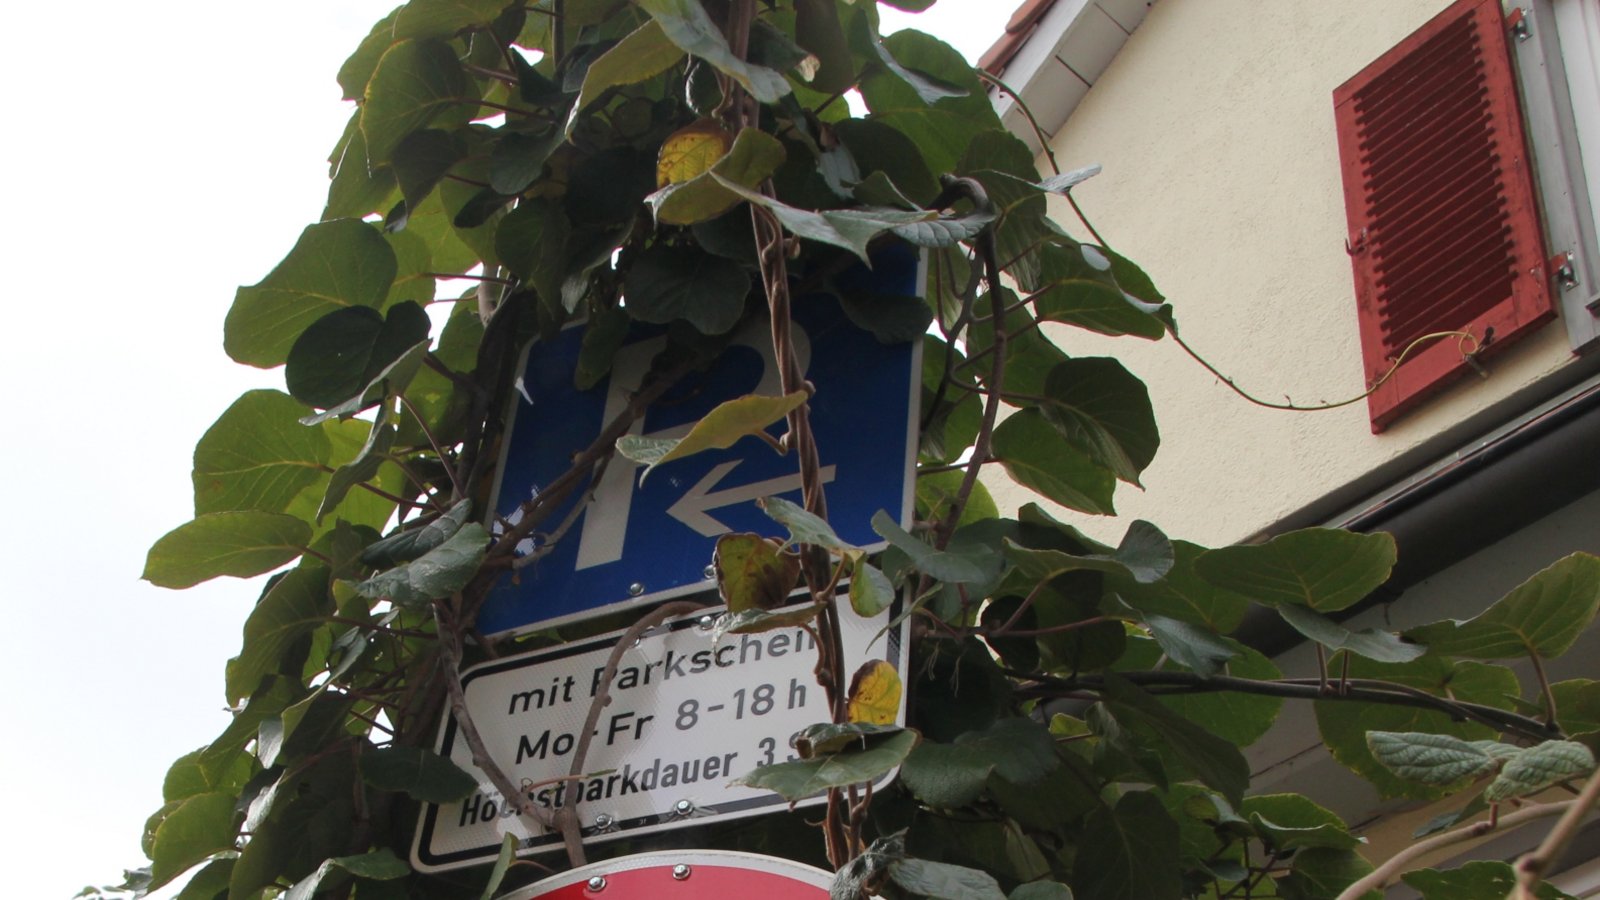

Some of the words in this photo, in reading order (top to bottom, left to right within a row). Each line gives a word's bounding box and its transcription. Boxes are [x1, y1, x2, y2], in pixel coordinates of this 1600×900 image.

[508, 675, 575, 715] mit
[788, 678, 807, 710] h
[756, 737, 776, 768] 3
